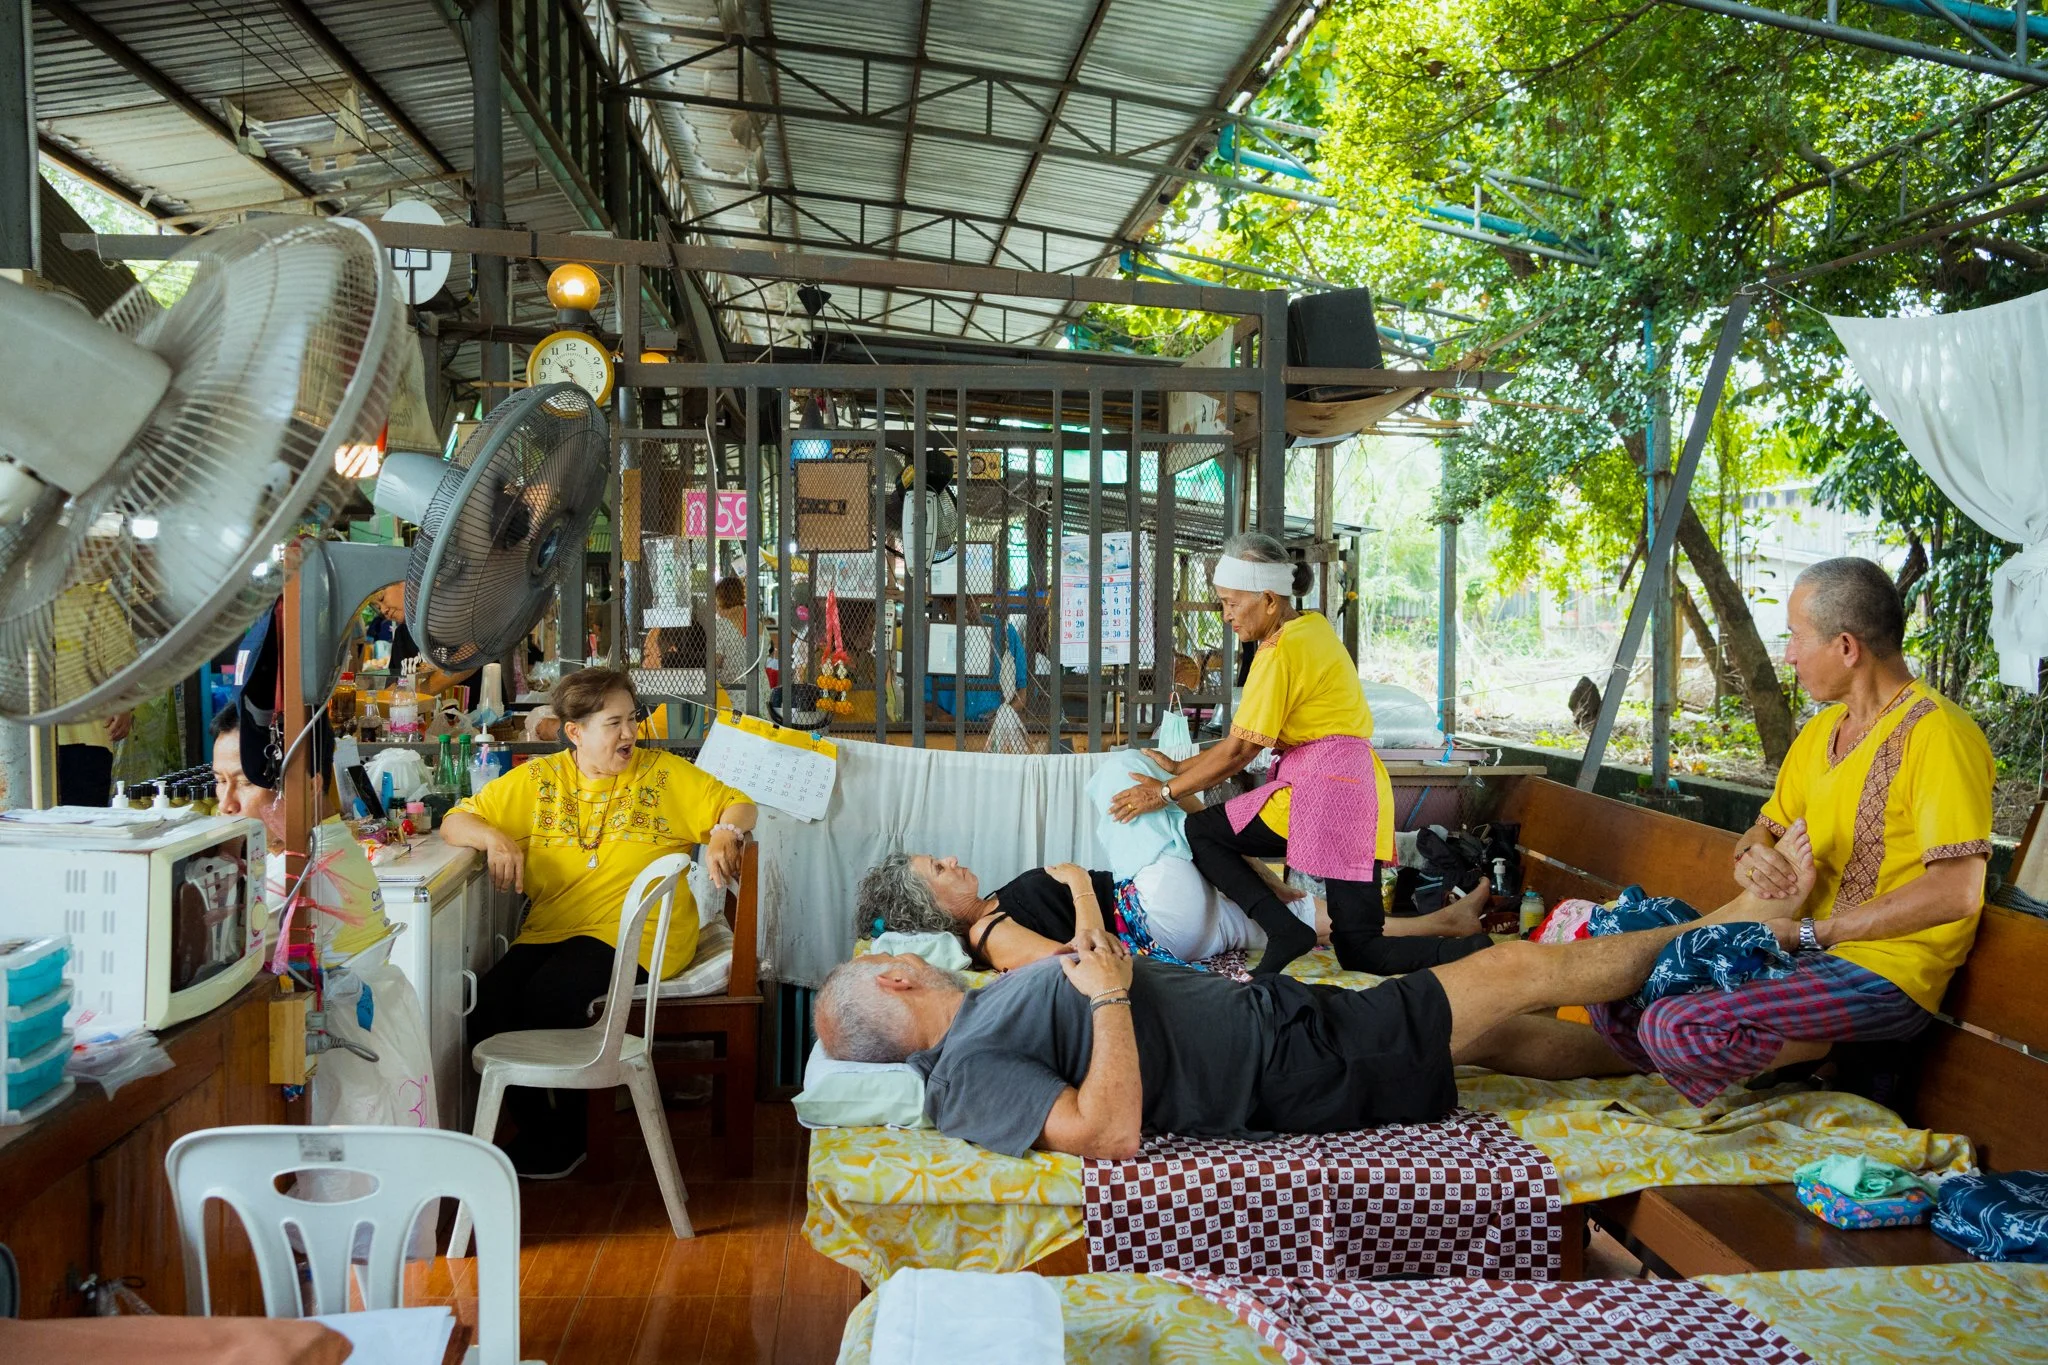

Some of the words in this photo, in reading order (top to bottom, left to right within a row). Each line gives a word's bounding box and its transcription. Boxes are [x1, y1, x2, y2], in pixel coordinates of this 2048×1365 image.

[551, 347, 559, 355] 11
[566, 343, 576, 351] 12
[596, 371, 603, 379] 3
